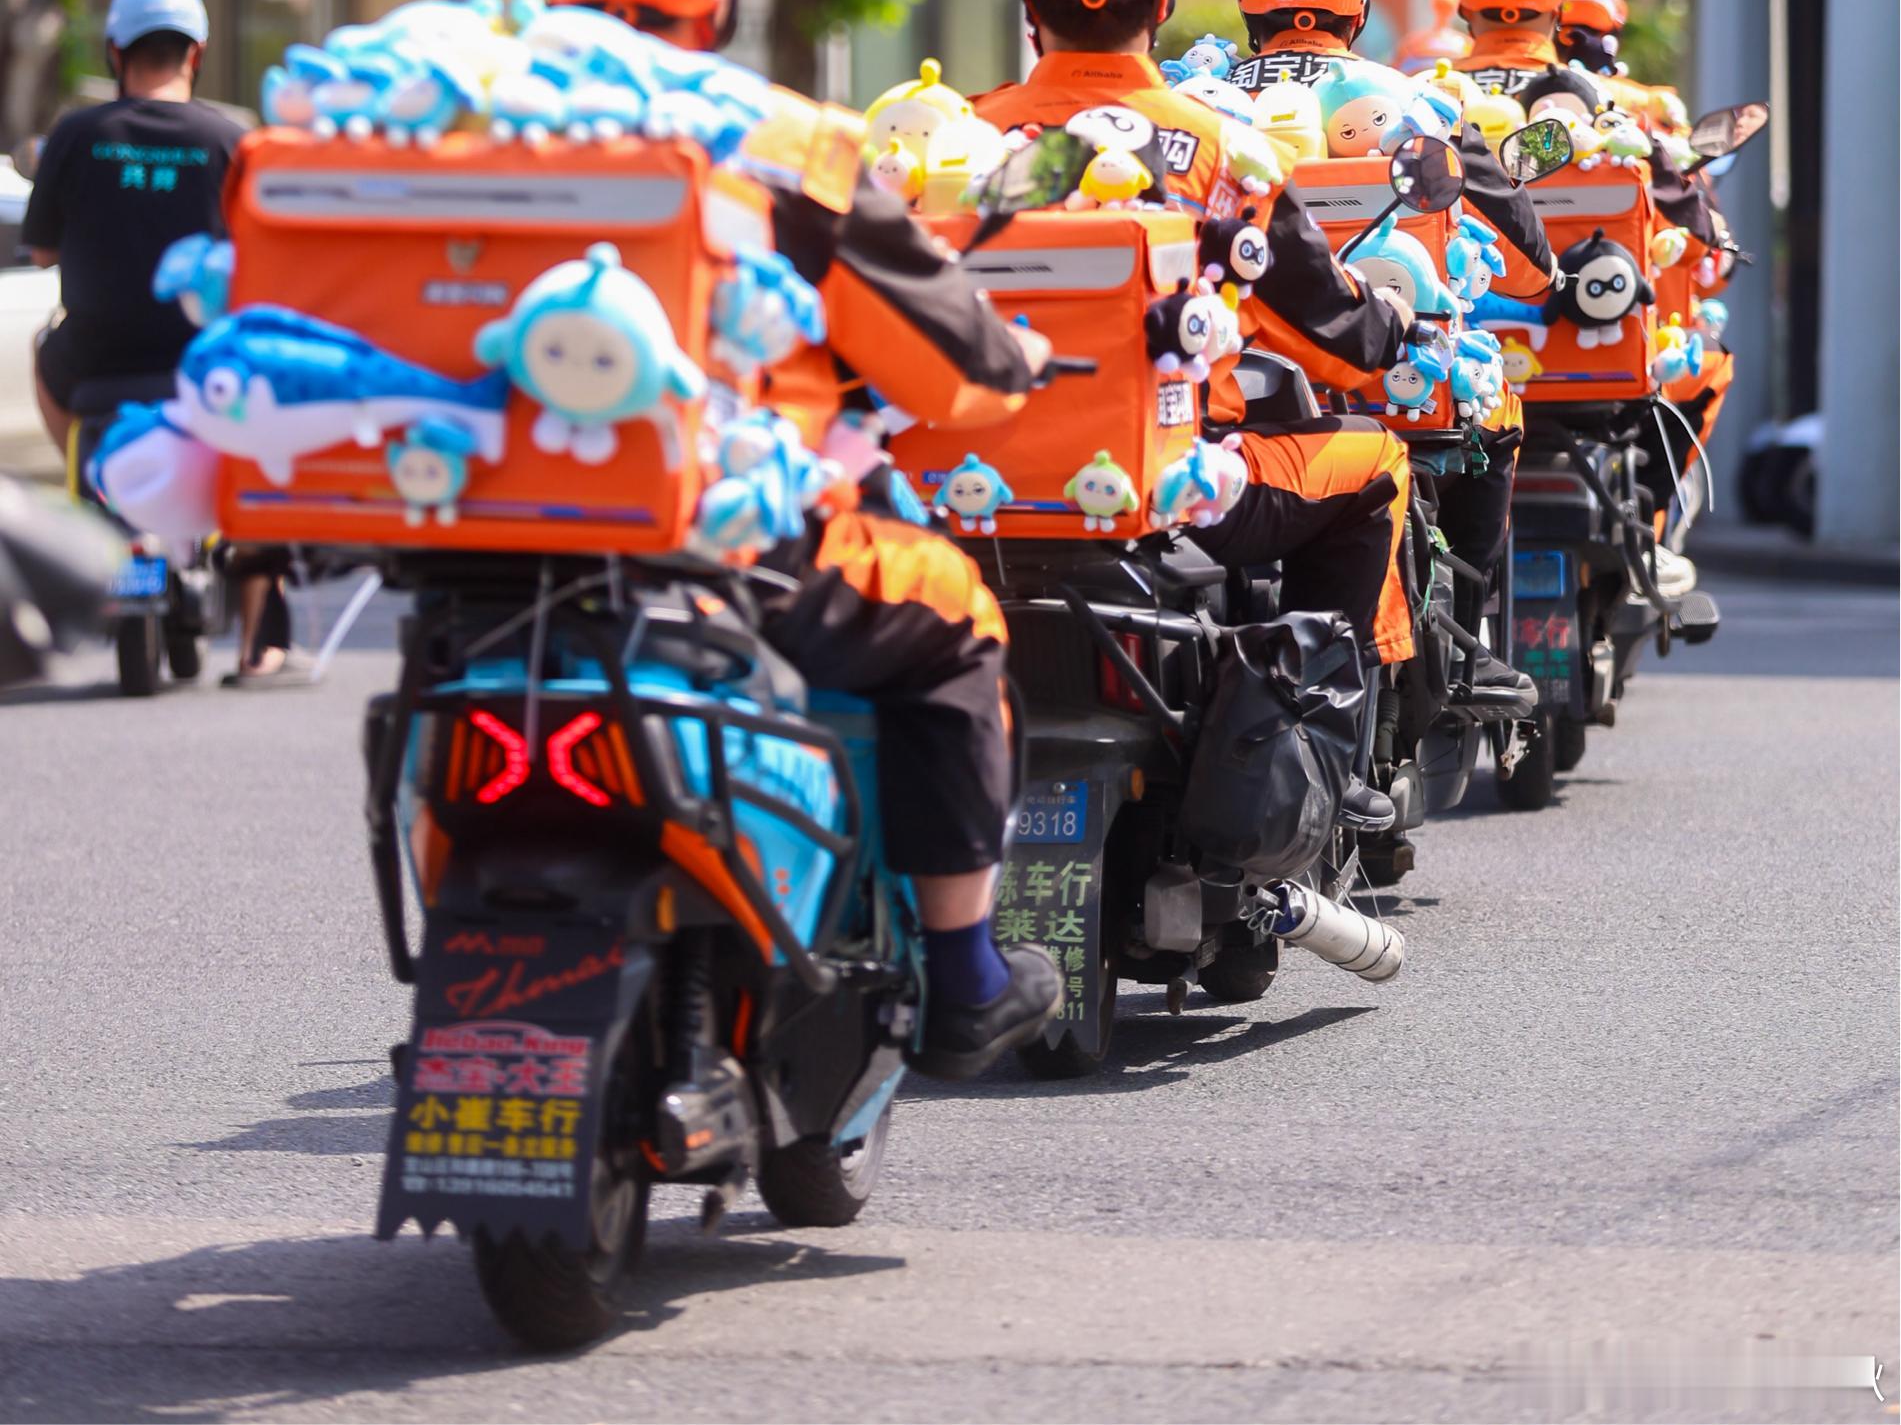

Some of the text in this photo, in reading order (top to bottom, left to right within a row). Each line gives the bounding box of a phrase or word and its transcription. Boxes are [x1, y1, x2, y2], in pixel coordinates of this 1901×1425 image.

[1017, 811, 1077, 836] 9318
[996, 909, 1086, 943] 莱达
[1067, 976, 1085, 998] 号
